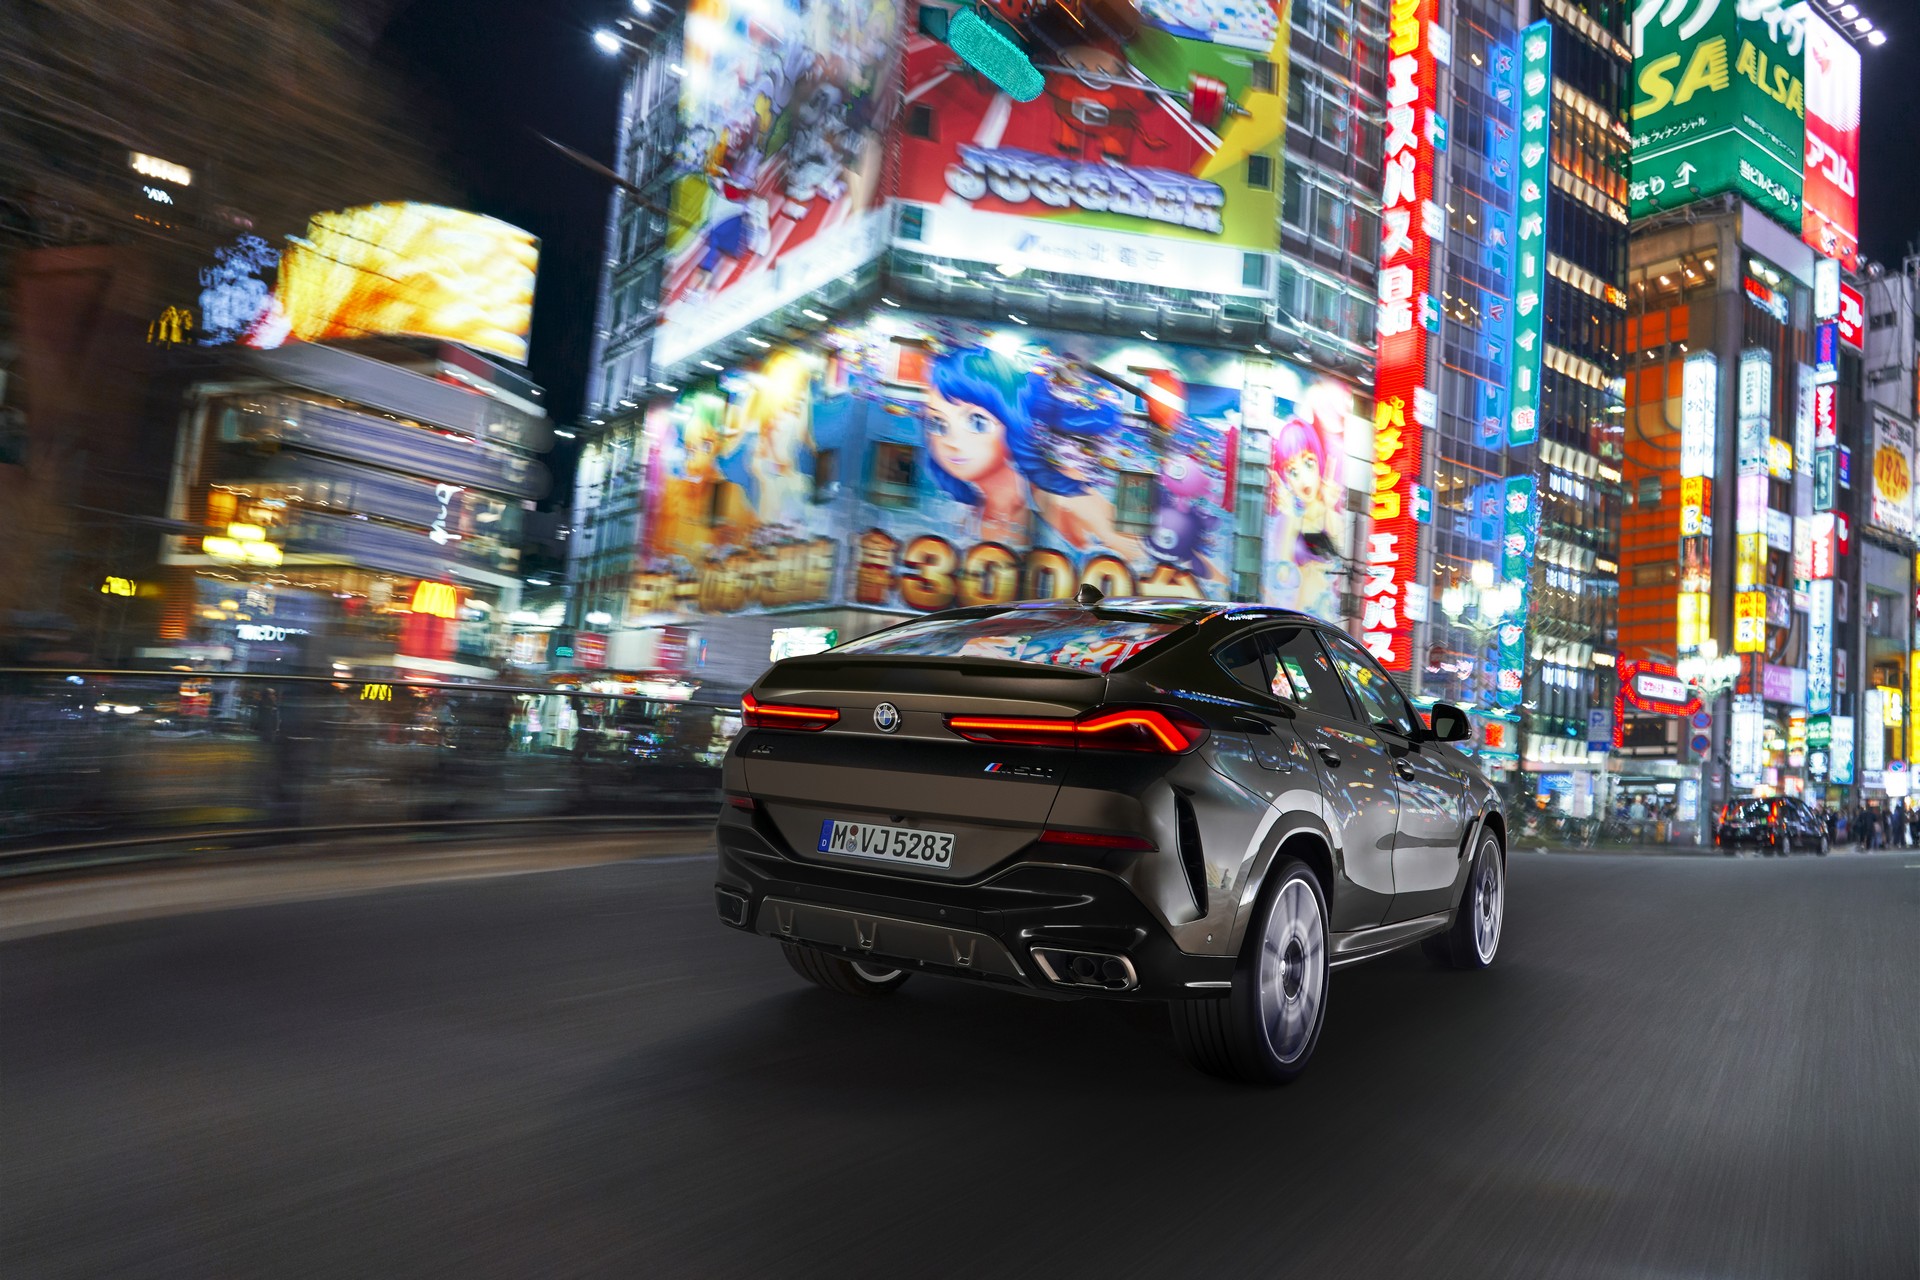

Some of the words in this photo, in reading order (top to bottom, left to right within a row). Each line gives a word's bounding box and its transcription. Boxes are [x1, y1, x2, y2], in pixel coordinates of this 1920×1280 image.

[1736, 38, 1804, 120] ALSA
[1370, 395, 1405, 520] パチンコ
[1362, 532, 1399, 663] エスパス
